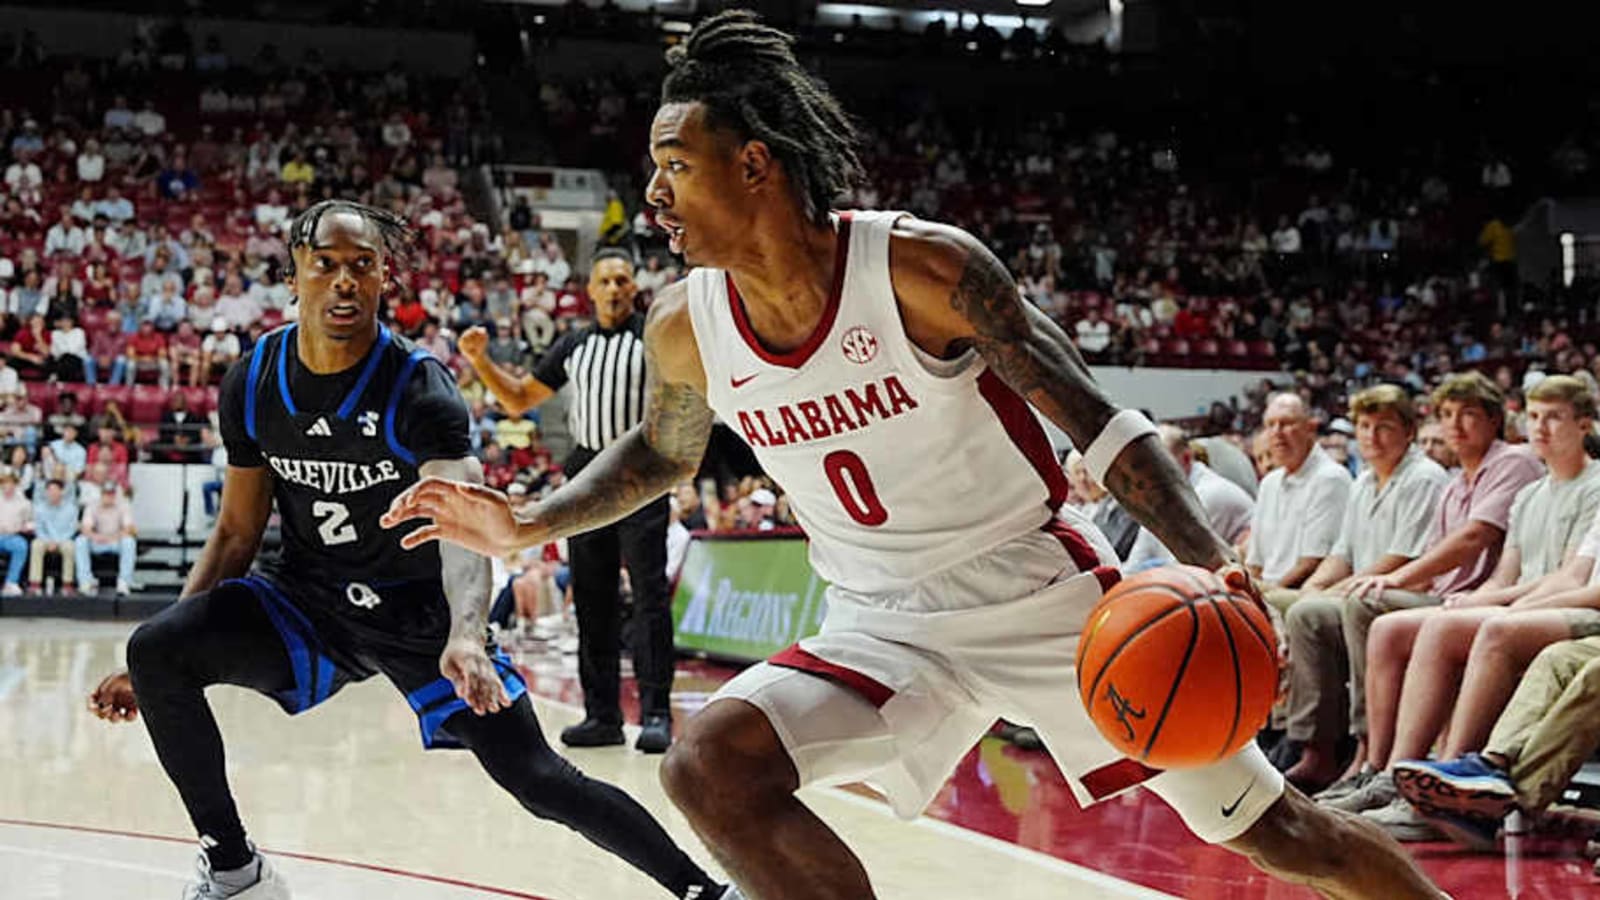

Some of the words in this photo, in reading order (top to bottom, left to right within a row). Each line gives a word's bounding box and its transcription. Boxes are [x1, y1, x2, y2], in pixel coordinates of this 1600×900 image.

[737, 376, 918, 447] ALABAMA
[312, 500, 358, 545] 2
[823, 449, 889, 527] 0
